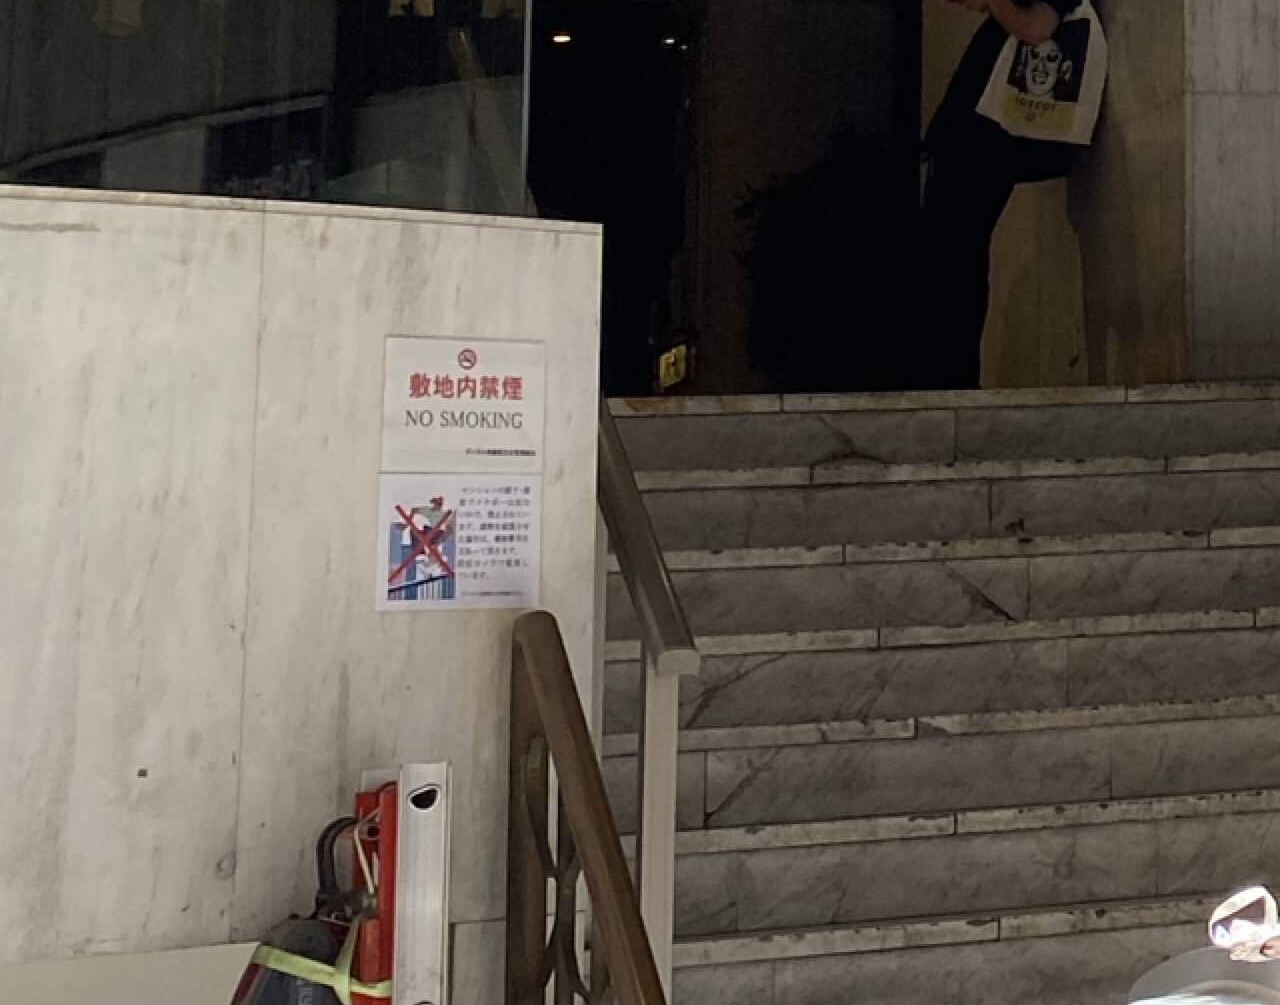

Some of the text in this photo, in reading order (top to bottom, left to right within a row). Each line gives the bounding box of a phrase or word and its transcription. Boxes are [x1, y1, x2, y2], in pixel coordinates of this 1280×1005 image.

[408, 371, 524, 401] 敷地内禁煙
[405, 409, 523, 430] NO SMOKING
